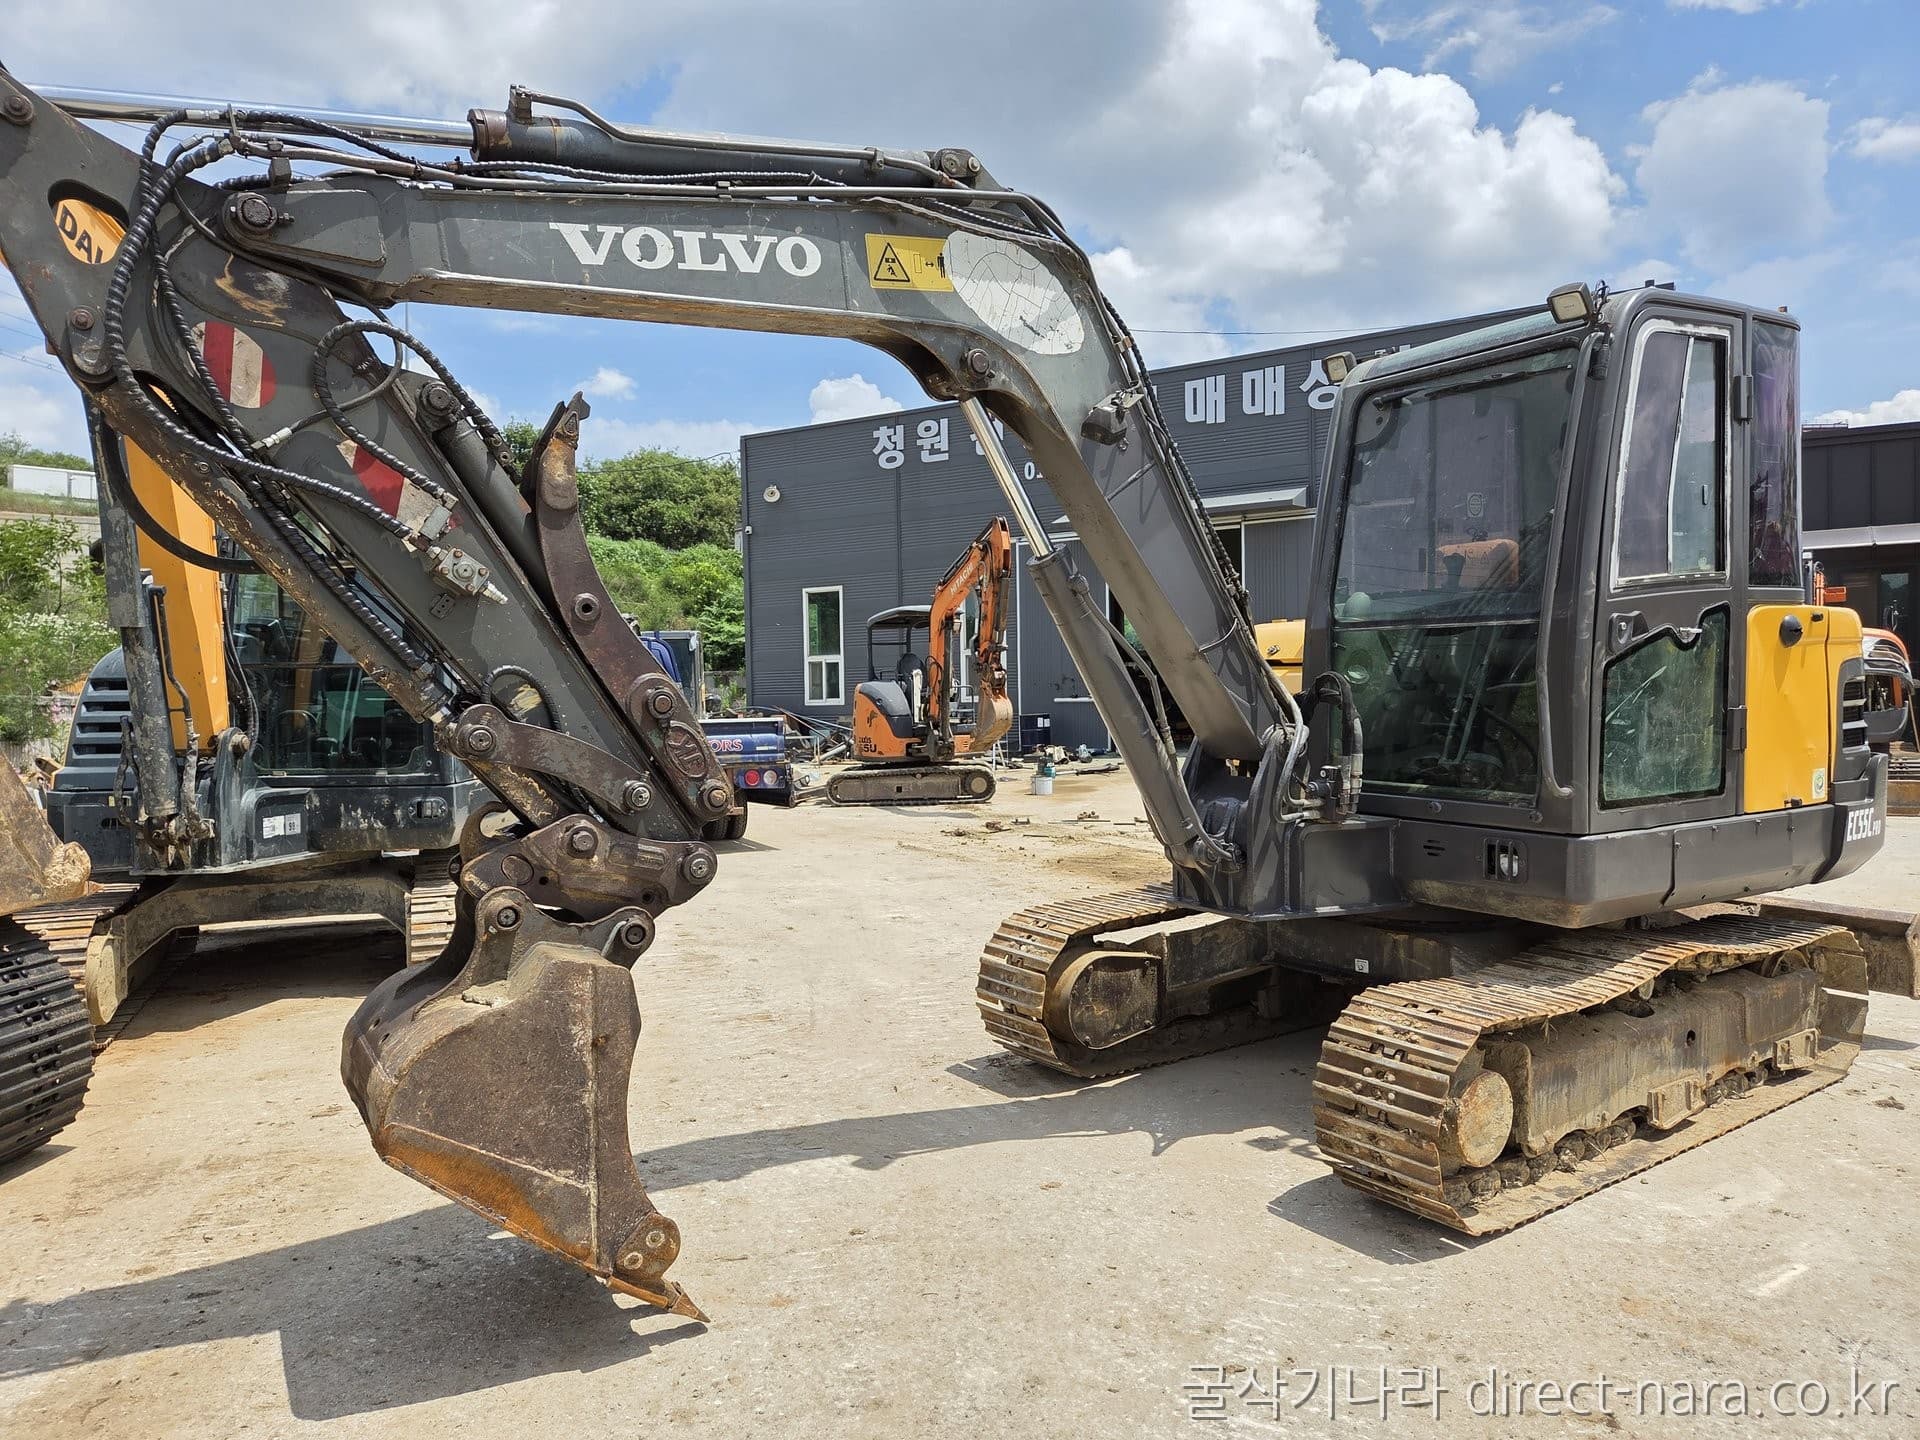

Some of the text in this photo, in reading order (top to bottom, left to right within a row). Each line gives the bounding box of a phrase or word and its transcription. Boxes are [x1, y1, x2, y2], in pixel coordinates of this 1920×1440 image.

[549, 222, 821, 277] VOLVO
[872, 418, 949, 469] 청원
[708, 738, 744, 753] ORS
[1846, 807, 1874, 842] EC55C
